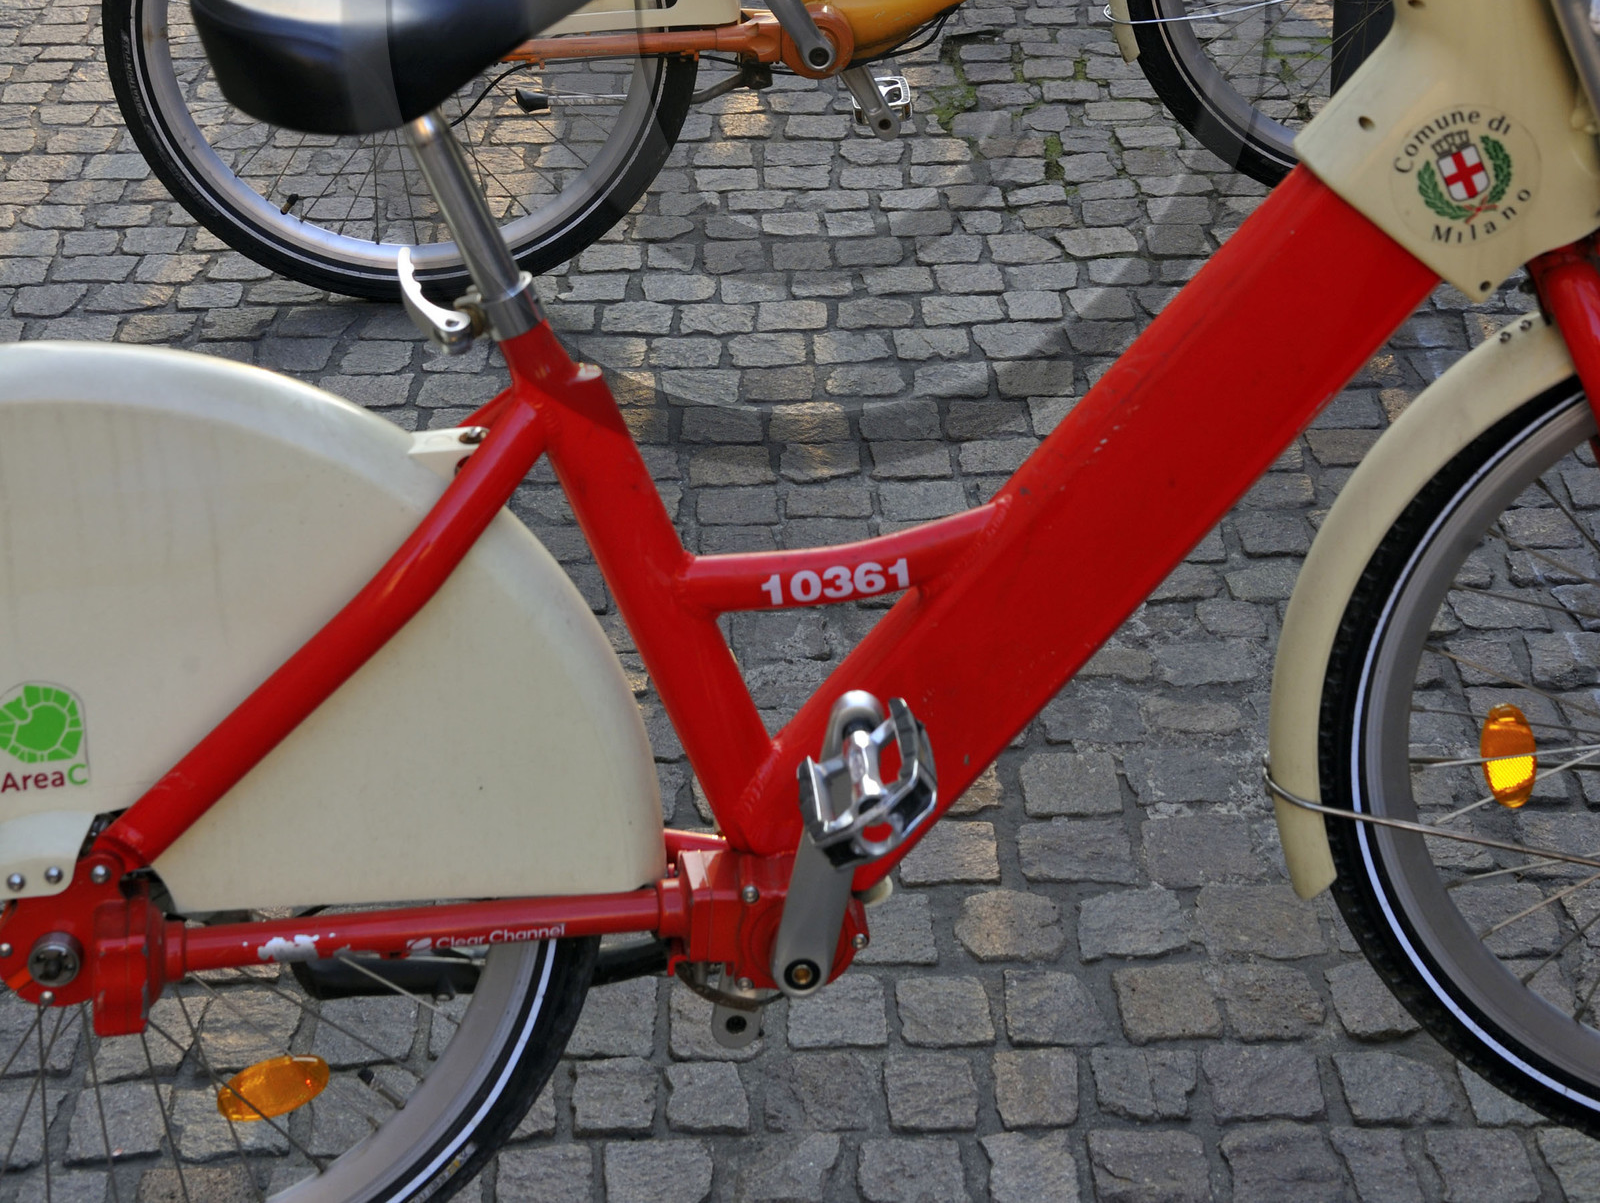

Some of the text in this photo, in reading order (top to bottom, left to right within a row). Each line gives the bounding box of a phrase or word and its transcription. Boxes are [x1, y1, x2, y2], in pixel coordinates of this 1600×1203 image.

[1394, 110, 1511, 174] Comune di
[1432, 189, 1532, 243] Milano
[761, 558, 910, 605] 10361
[436, 923, 566, 949] Clear Channel
